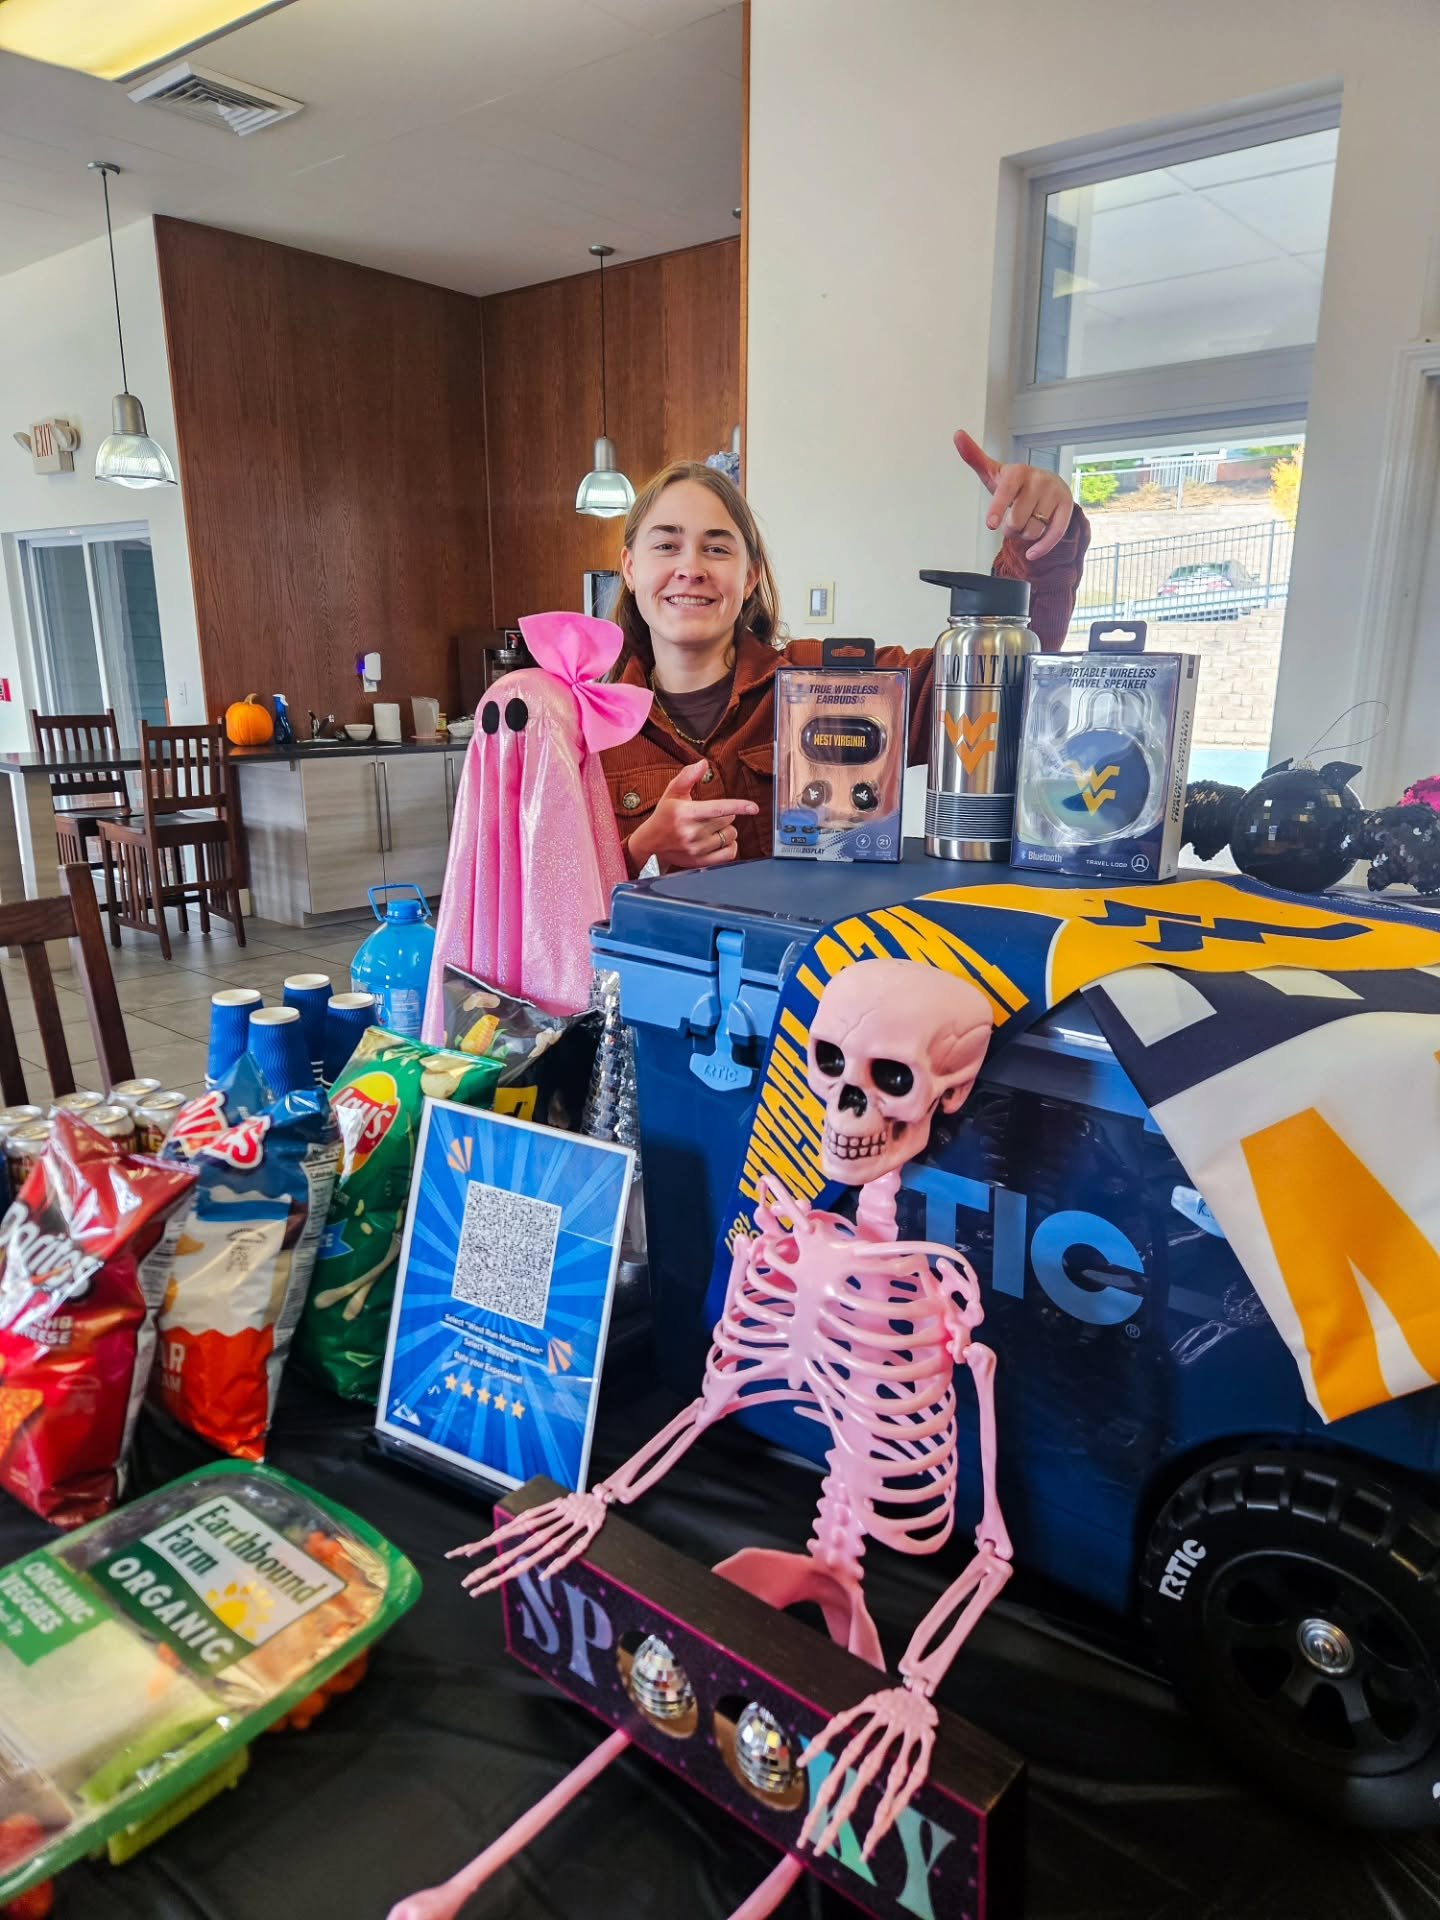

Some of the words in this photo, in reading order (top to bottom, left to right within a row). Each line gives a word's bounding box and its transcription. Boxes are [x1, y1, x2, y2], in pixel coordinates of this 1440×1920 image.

[33, 423, 54, 458] EXIT
[1060, 667, 1107, 679] PORTABLE
[1109, 667, 1157, 679] WIRELESS
[1068, 678, 1101, 689] TRAVEL
[1103, 678, 1147, 690] SPEAKER
[809, 684, 833, 695] TRUE
[834, 684, 879, 696] WIRELESS
[816, 695, 858, 705] EARBUDS
[813, 734, 833, 747] WEST
[834, 735, 866, 748] VIRGINIA
[802, 847, 825, 855] DISPLAY
[1028, 851, 1062, 863] Bluetooth
[1086, 859, 1109, 867] TRAVEL
[0, 1200, 98, 1298] Doritos
[157, 1522, 220, 1577] Farm
[195, 1502, 328, 1606] Earthbound
[1158, 1538, 1208, 1601] RTIC
[0, 1573, 64, 1635] VEGGIES
[24, 1561, 95, 1624] ORGANIC
[108, 1556, 235, 1664] ORGANIC
